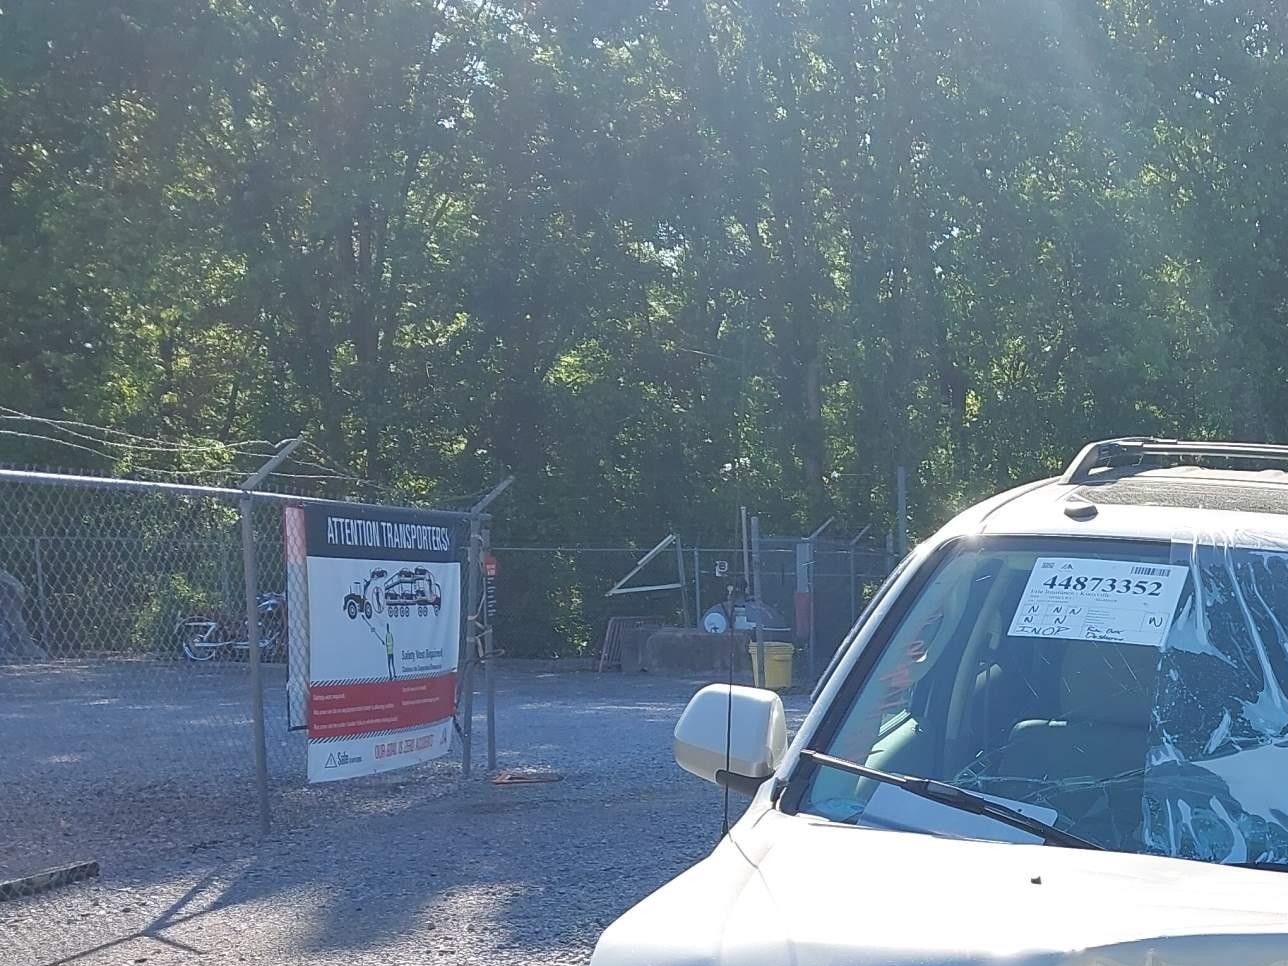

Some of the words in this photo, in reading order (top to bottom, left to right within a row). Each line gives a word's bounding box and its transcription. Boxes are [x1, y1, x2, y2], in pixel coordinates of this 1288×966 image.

[327, 516, 380, 547] ATTENTION
[380, 521, 450, 551] TRANSPORTERS!
[1043, 574, 1163, 597] 44873352
[1015, 625, 1071, 636] INOP
